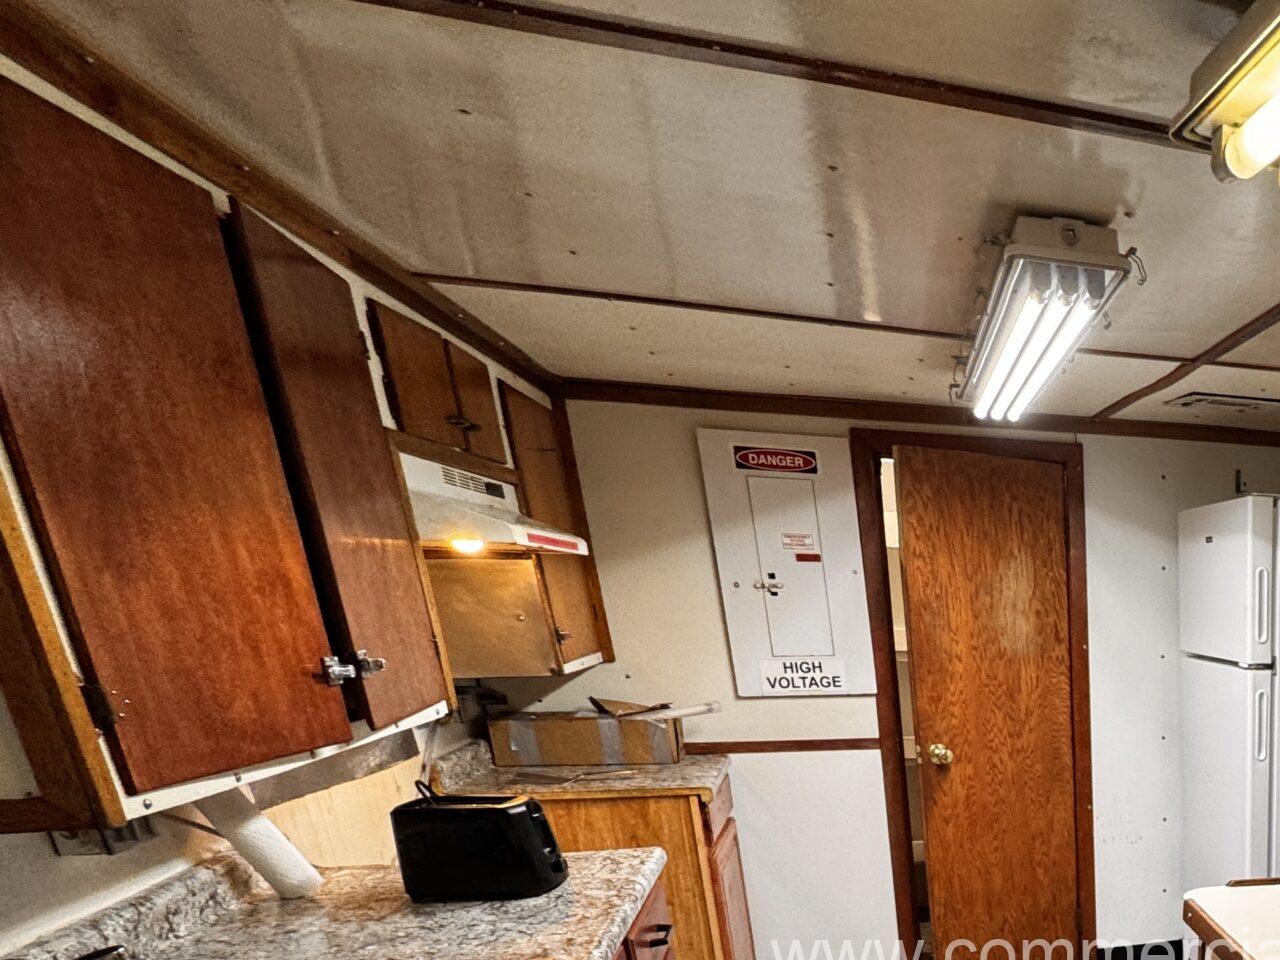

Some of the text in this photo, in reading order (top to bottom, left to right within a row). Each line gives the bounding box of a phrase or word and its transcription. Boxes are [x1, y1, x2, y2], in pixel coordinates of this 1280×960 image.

[748, 453, 804, 467] DANGER
[783, 661, 822, 673] HIGH
[766, 676, 842, 688] VOLTAGE
